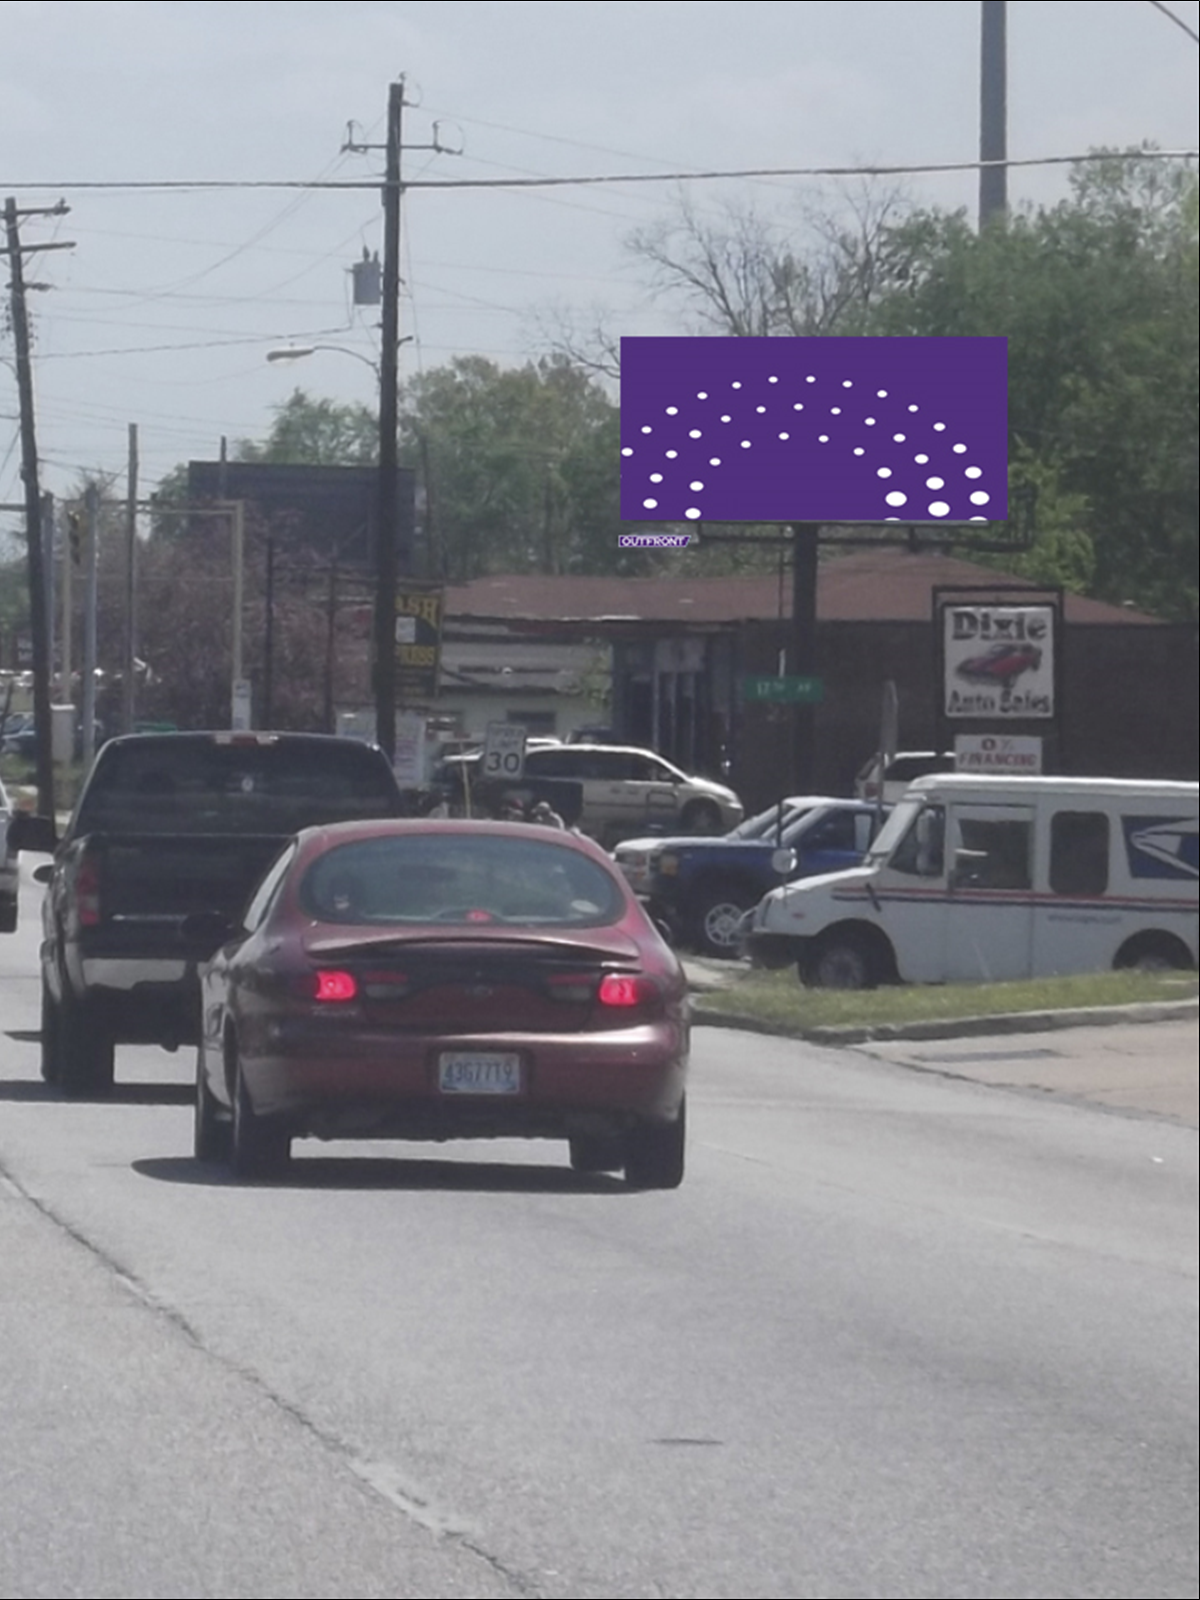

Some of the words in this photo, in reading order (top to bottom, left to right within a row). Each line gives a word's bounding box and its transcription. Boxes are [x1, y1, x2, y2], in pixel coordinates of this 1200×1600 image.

[621, 535, 685, 547] OUTFRONT
[952, 611, 1047, 641] Dixie
[948, 689, 996, 713] Auto
[999, 688, 1050, 713] Sales
[487, 751, 519, 773] 30
[959, 752, 1037, 767] FINANCING
